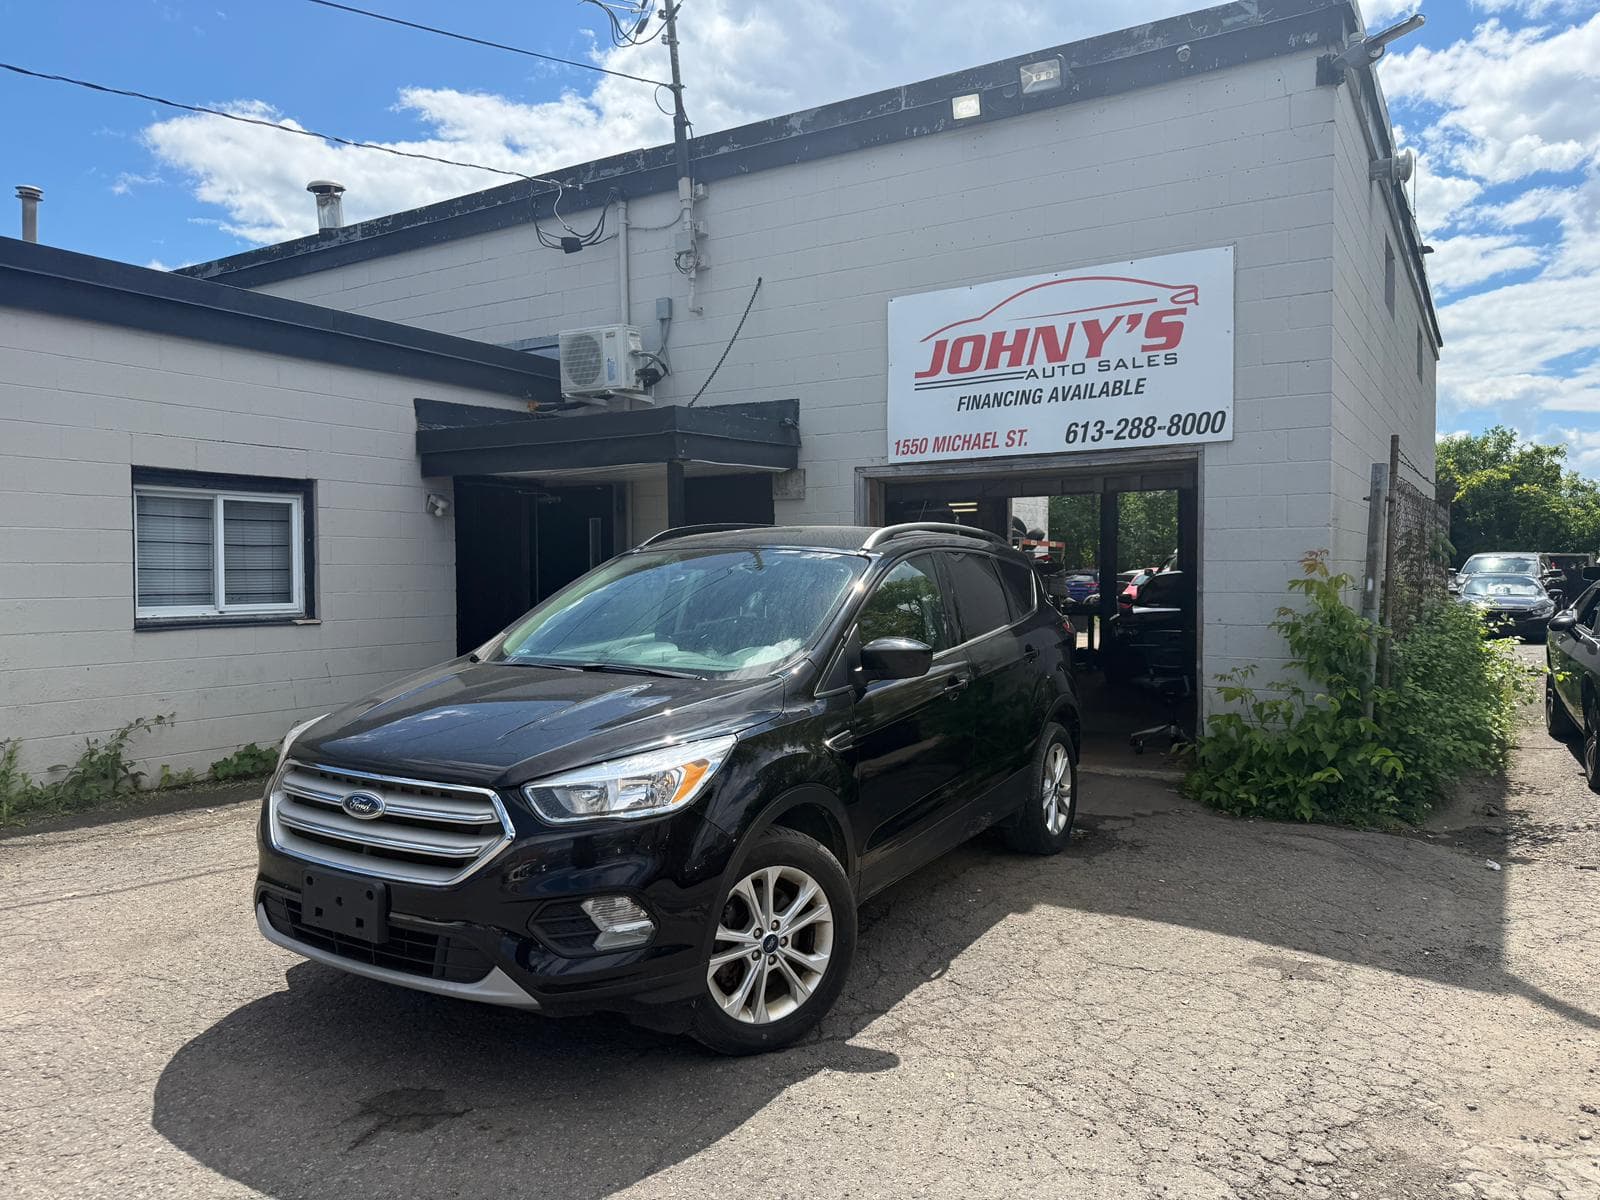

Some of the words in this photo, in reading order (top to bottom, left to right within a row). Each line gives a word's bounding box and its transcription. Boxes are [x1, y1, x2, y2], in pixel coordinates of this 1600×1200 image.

[914, 307, 1187, 379] JOHNY'S
[1025, 362, 1086, 380] AUTO
[1098, 353, 1178, 372] SALES
[957, 387, 1043, 412] FINANCING
[1048, 378, 1146, 403] AVAILABLE
[894, 437, 928, 456] 1550
[932, 431, 999, 453] MICHAEL
[1005, 429, 1028, 447] ST.
[1065, 410, 1226, 444] 613-288-8000
